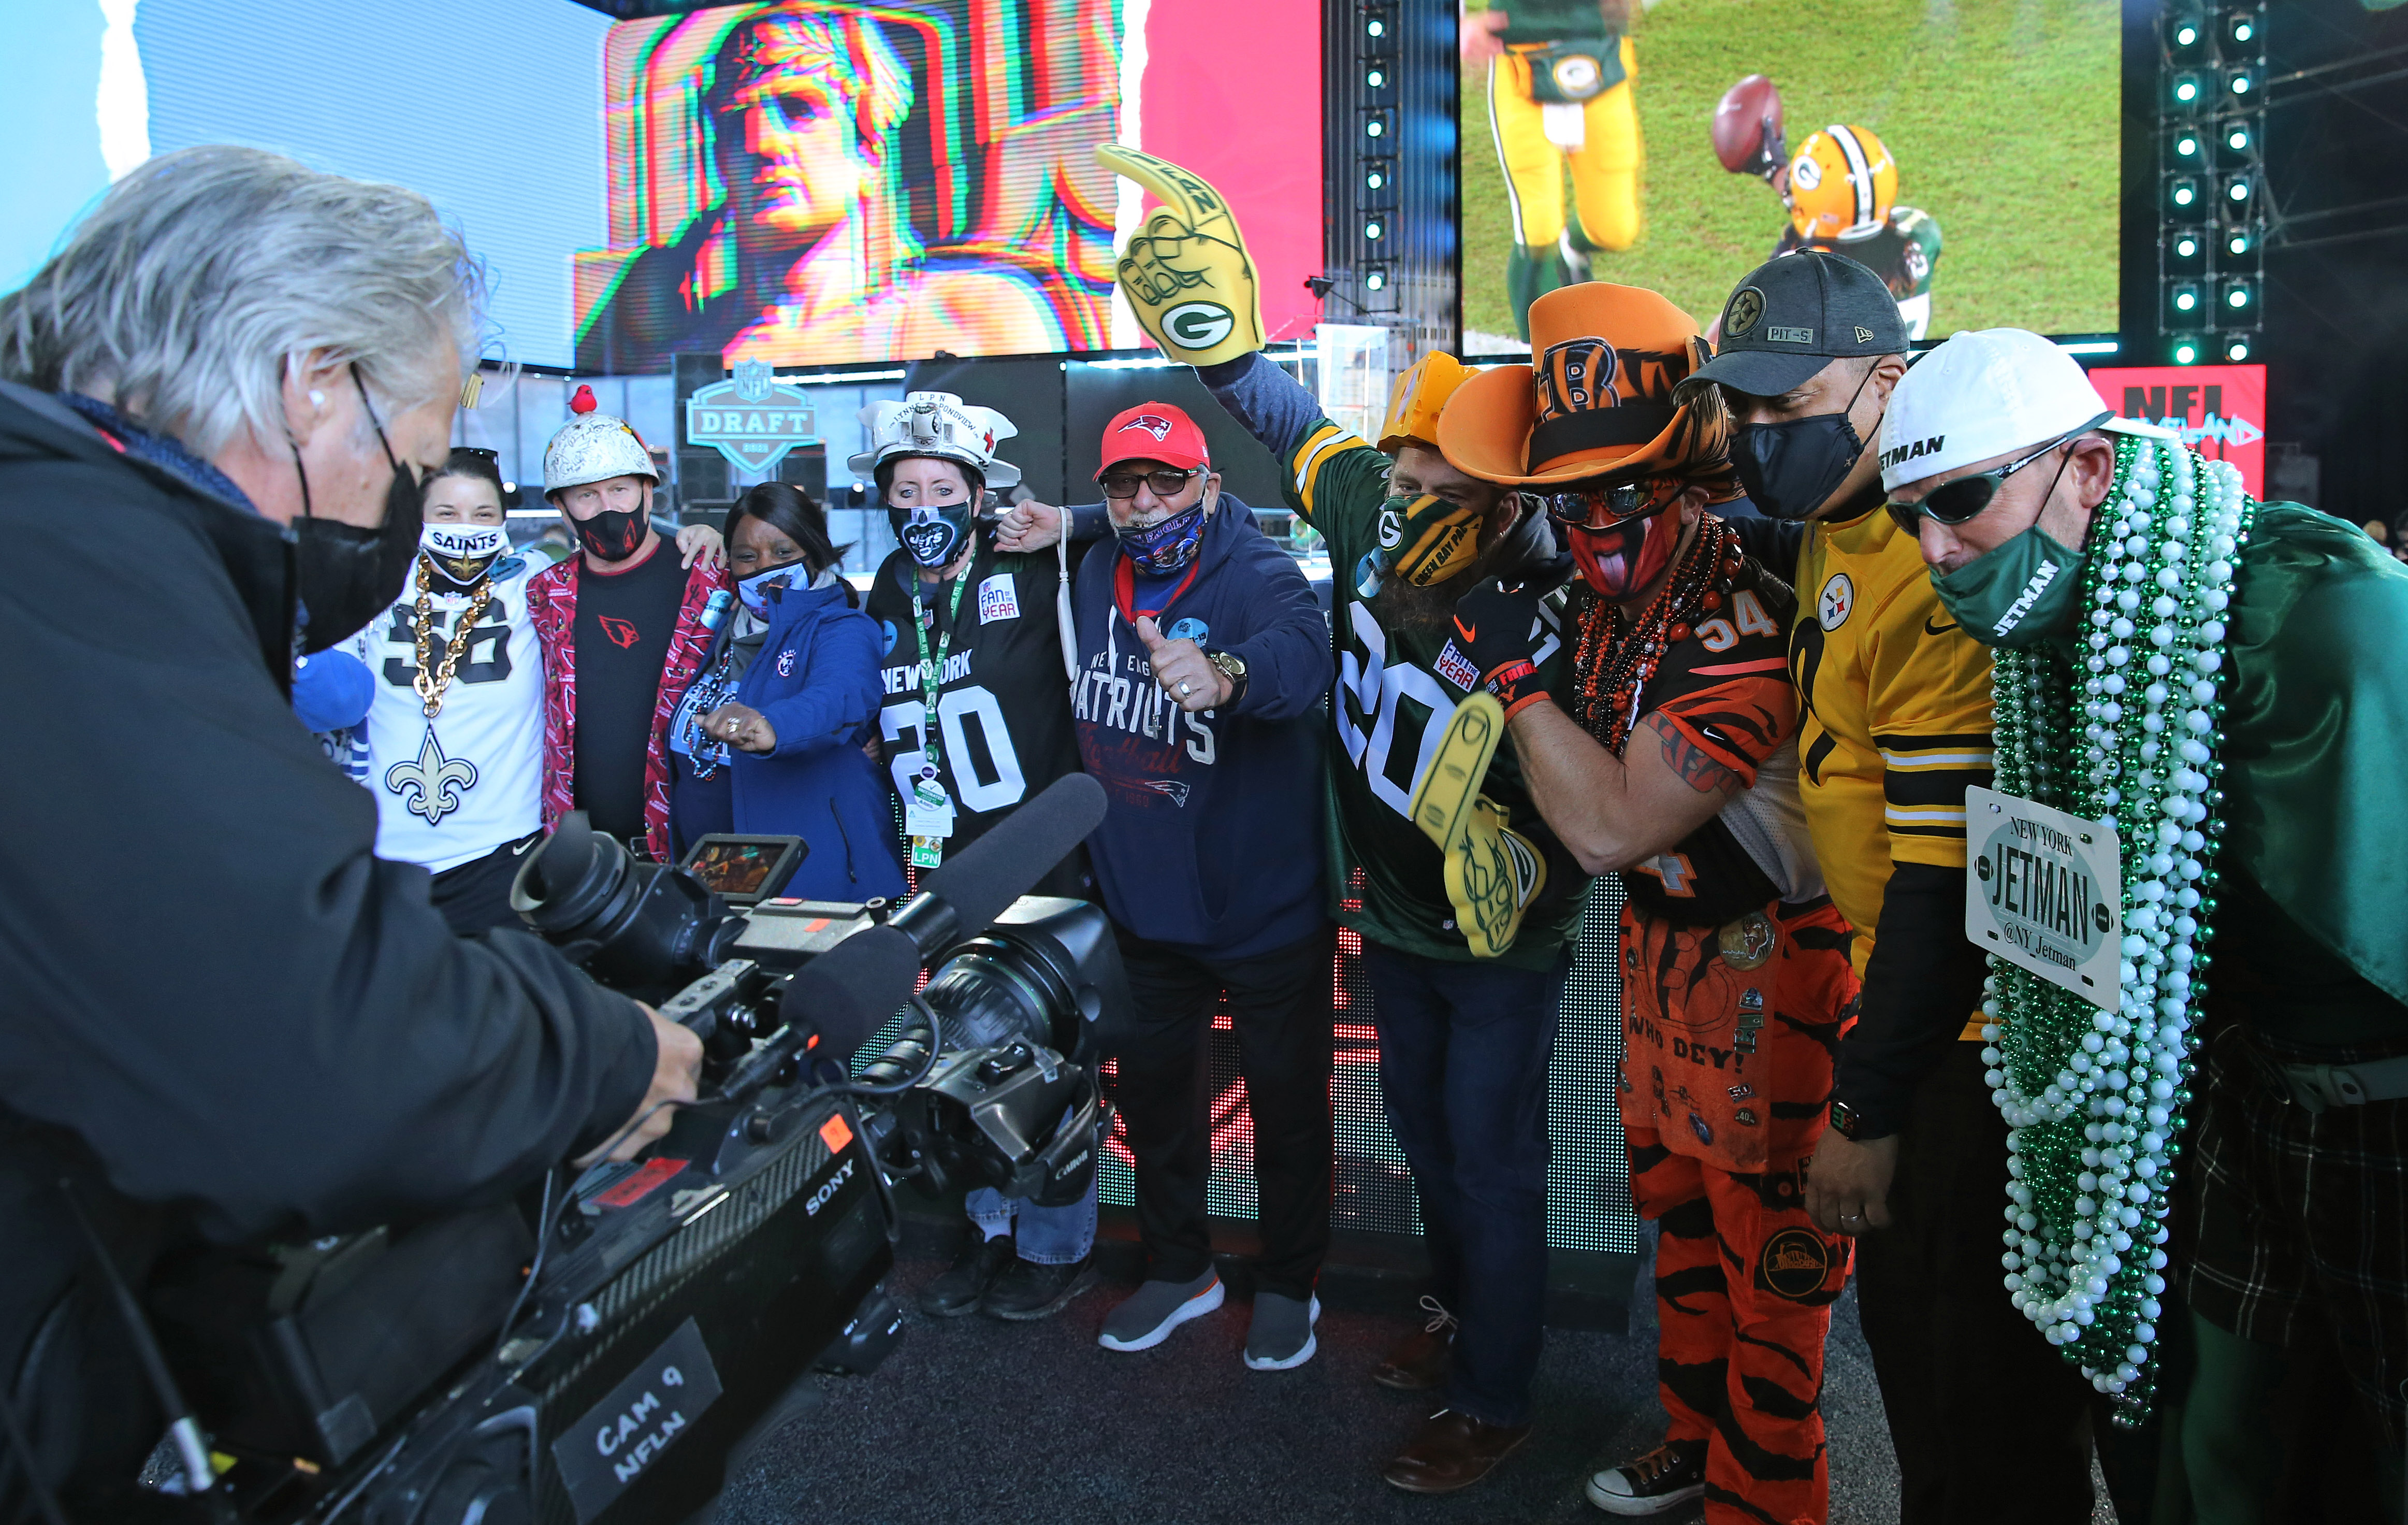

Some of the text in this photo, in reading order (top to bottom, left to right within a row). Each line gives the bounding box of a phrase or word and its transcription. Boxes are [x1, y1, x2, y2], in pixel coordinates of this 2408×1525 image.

[1161, 304, 1232, 349] G
[701, 411, 808, 433] DRAFT
[939, 403, 976, 430] PONDVIEW
[1879, 435, 1946, 472] ETMAN
[433, 530, 498, 551] SAINTS
[909, 531, 944, 548] JETS
[1378, 511, 1402, 548] G
[1414, 558, 1440, 586] GREEN
[1435, 540, 1455, 565] BAY
[981, 589, 1005, 608] FAN
[982, 603, 1016, 620] YEAR
[1992, 559, 2059, 637] JETMAN
[1694, 588, 1779, 653] 54
[880, 649, 973, 695] NEW ORK
[1439, 655, 1474, 689] YEAR
[879, 685, 1027, 813] 20
[2010, 816, 2073, 856] NEW YORK
[914, 852, 938, 865] LPN
[1992, 843, 2088, 945] JETMAN
[1629, 1015, 1745, 1075] WHO DEY!
[1728, 1083, 1752, 1099] 50
[1739, 1112, 1749, 1121] 40
[1055, 1149, 1088, 1181] Canon
[805, 1159, 855, 1217] SONY
[596, 1365, 685, 1456] CAM 9
[614, 1409, 687, 1483] NFLN
